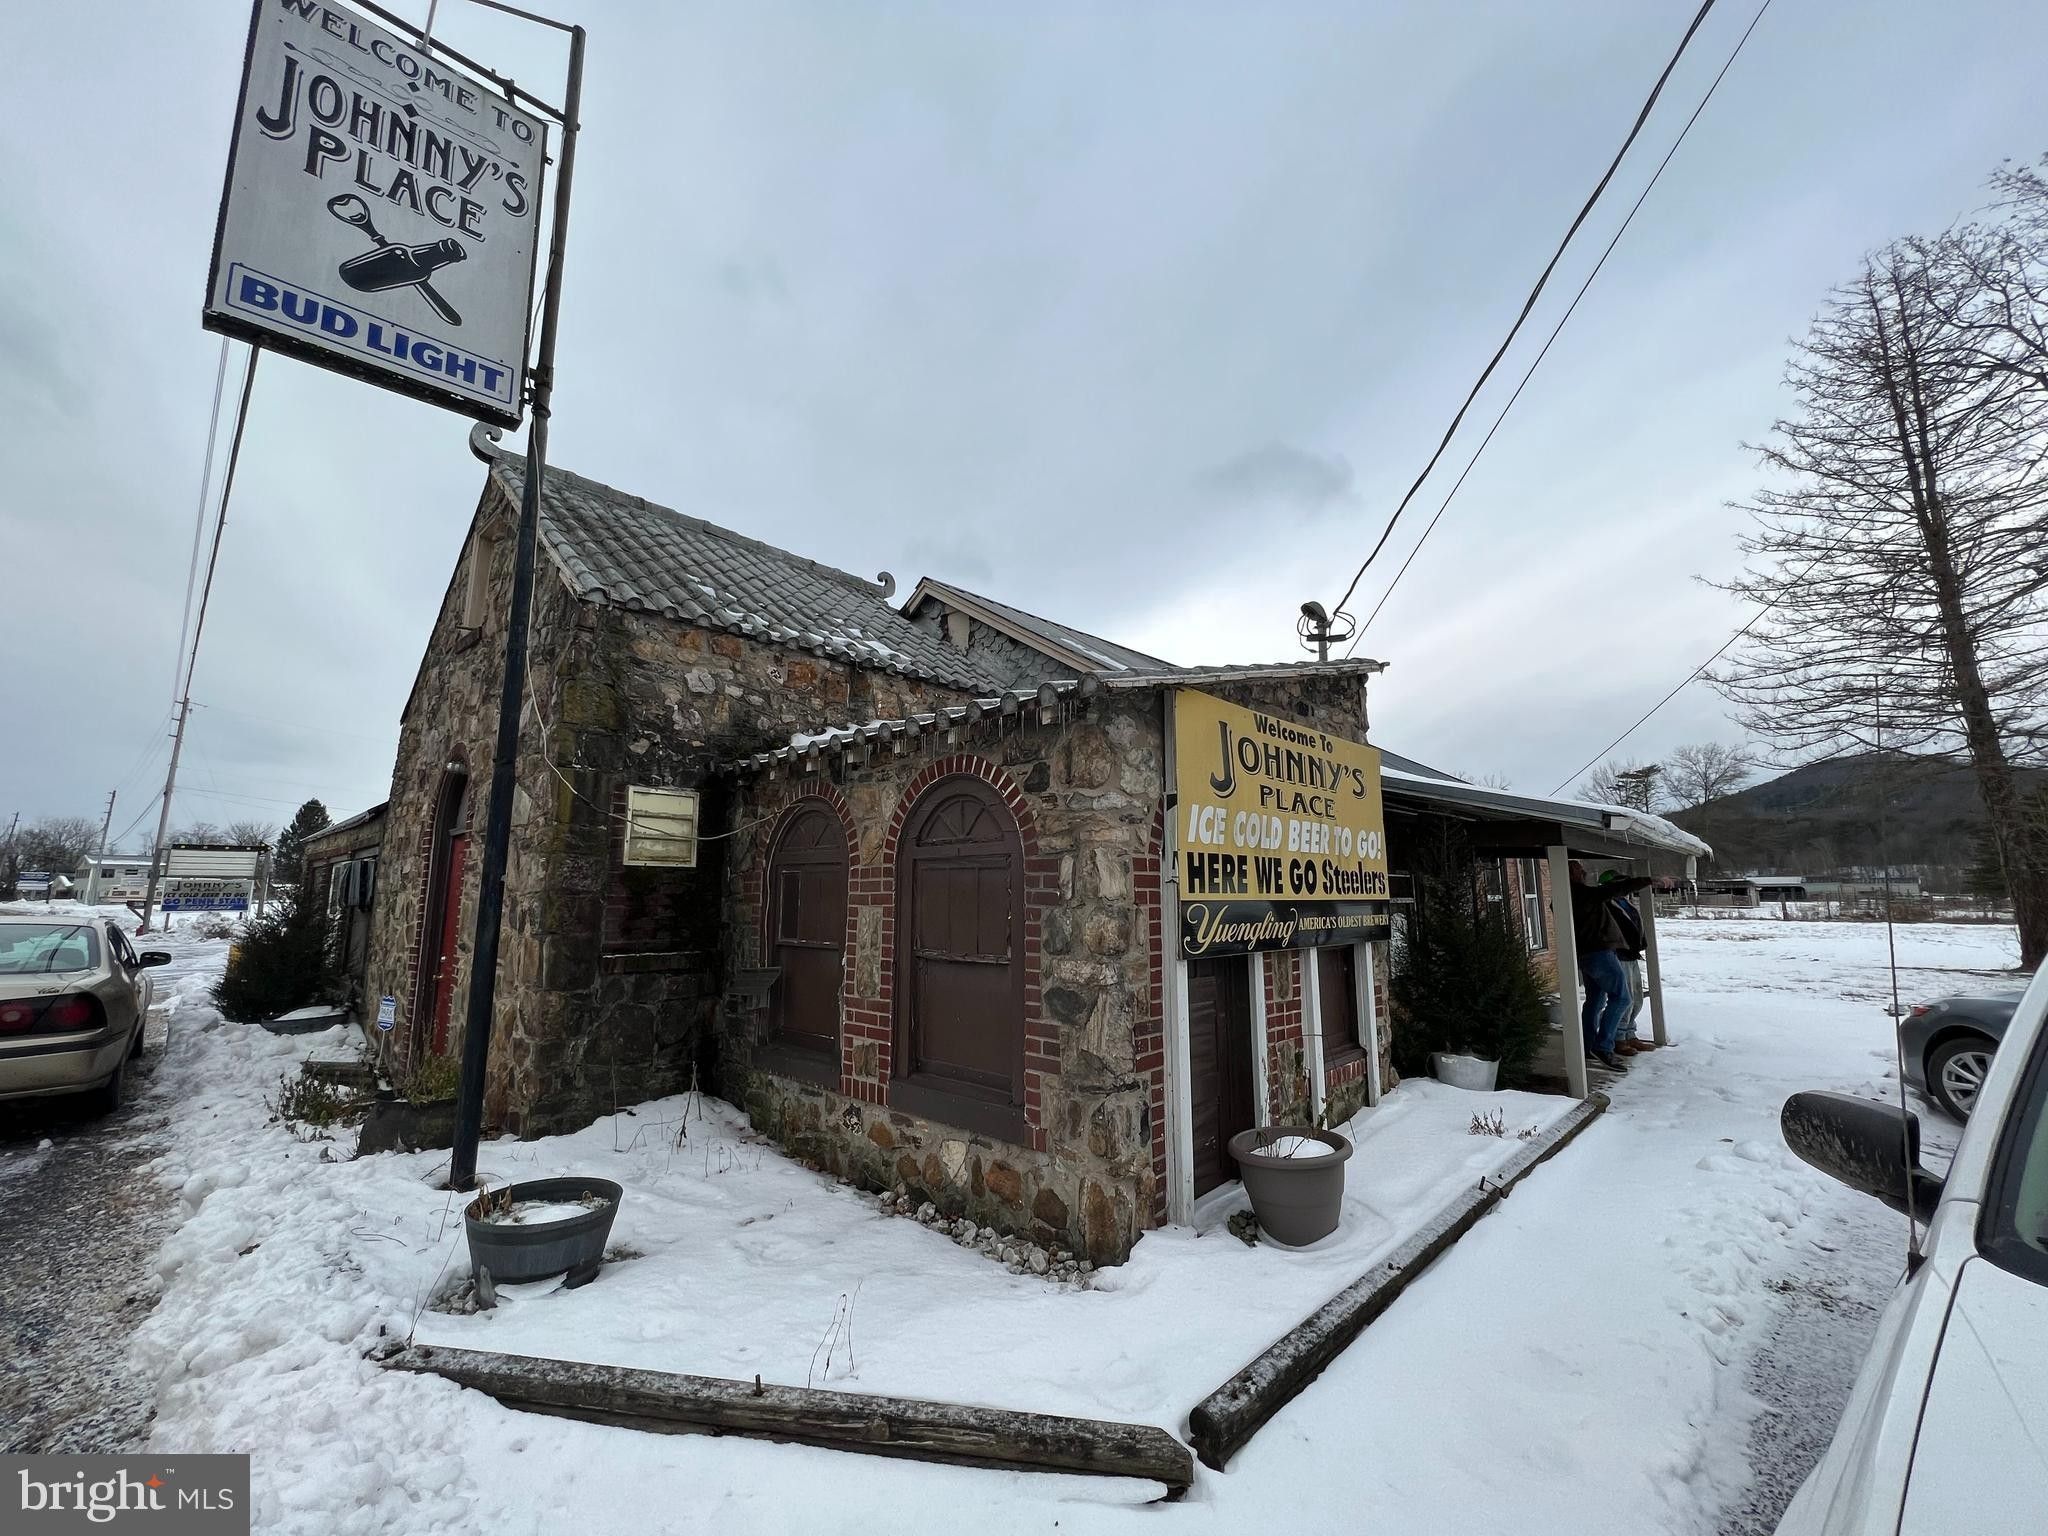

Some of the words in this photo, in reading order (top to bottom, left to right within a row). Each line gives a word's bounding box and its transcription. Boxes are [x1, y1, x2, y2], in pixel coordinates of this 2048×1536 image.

[256, 54, 530, 217] JOHNNY'S
[491, 105, 534, 146] TO
[303, 124, 486, 242] PLACE
[239, 274, 358, 338] BUD
[366, 322, 504, 392] LIGHT
[1210, 720, 1367, 798] JOHNNY'S
[1253, 713, 1317, 749] Welcome
[1320, 734, 1333, 754] To
[1259, 784, 1336, 820] PLACE
[1187, 804, 1227, 845] ICE
[1233, 810, 1283, 850] COLD
[1288, 818, 1329, 855] BEER
[1333, 827, 1352, 857] TO
[1356, 829, 1383, 860] GO!
[1186, 852, 1248, 894] HERE
[1253, 856, 1284, 894] WE
[1289, 858, 1317, 895] GO
[1322, 858, 1386, 895] Steelers
[1183, 903, 1298, 955] Yuengling
[1299, 916, 1337, 930] AMERICA'S
[1338, 915, 1361, 928] OLDEST
[1363, 914, 1389, 926] BREWERY
